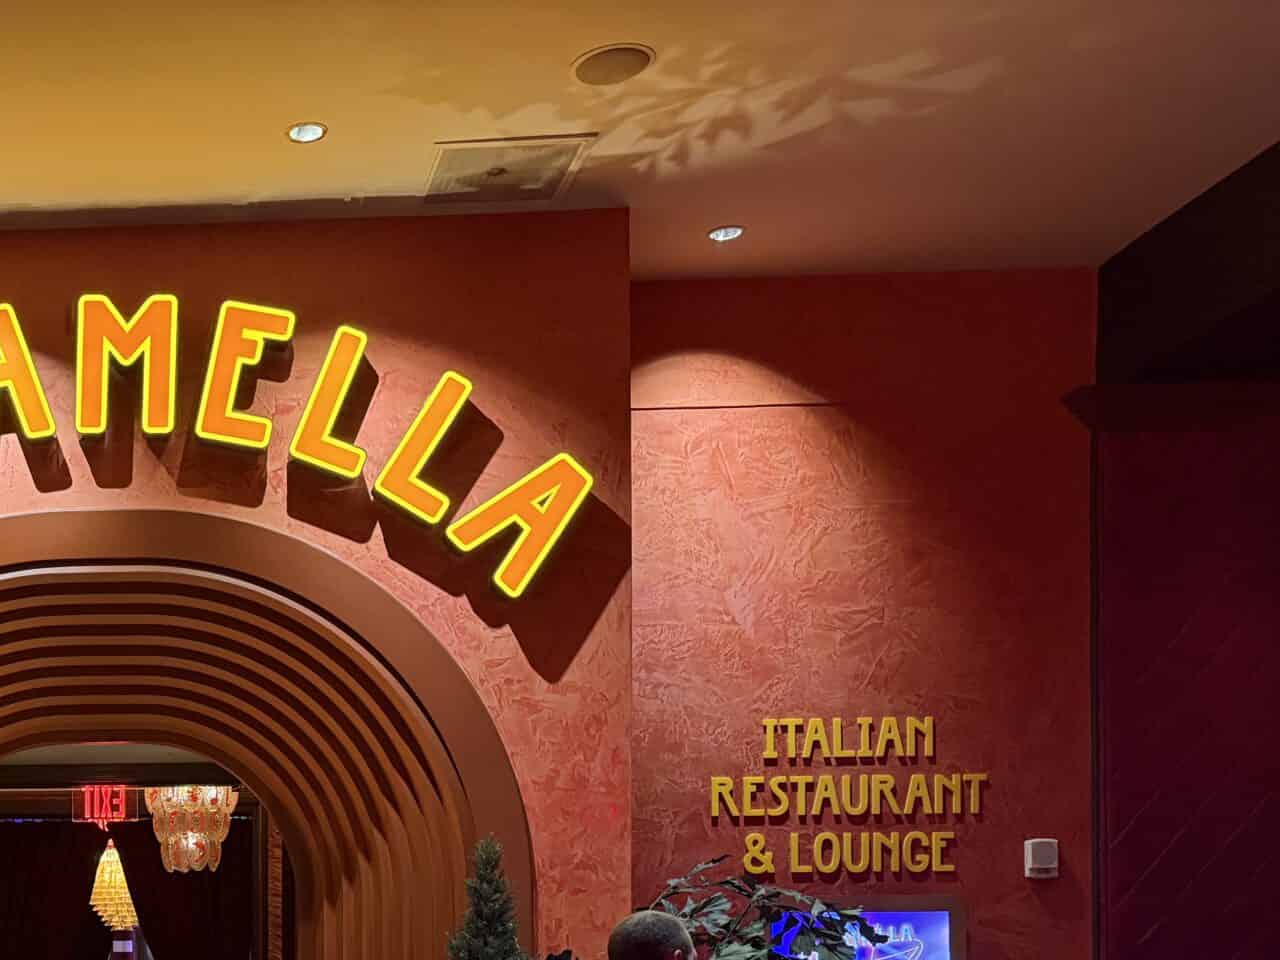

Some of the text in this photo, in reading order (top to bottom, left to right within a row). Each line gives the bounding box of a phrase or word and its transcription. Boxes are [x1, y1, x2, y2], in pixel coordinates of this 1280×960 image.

[762, 716, 933, 759] ITALIAN
[711, 773, 987, 817] RESTAURANT
[743, 831, 955, 873] & LOUNGE
